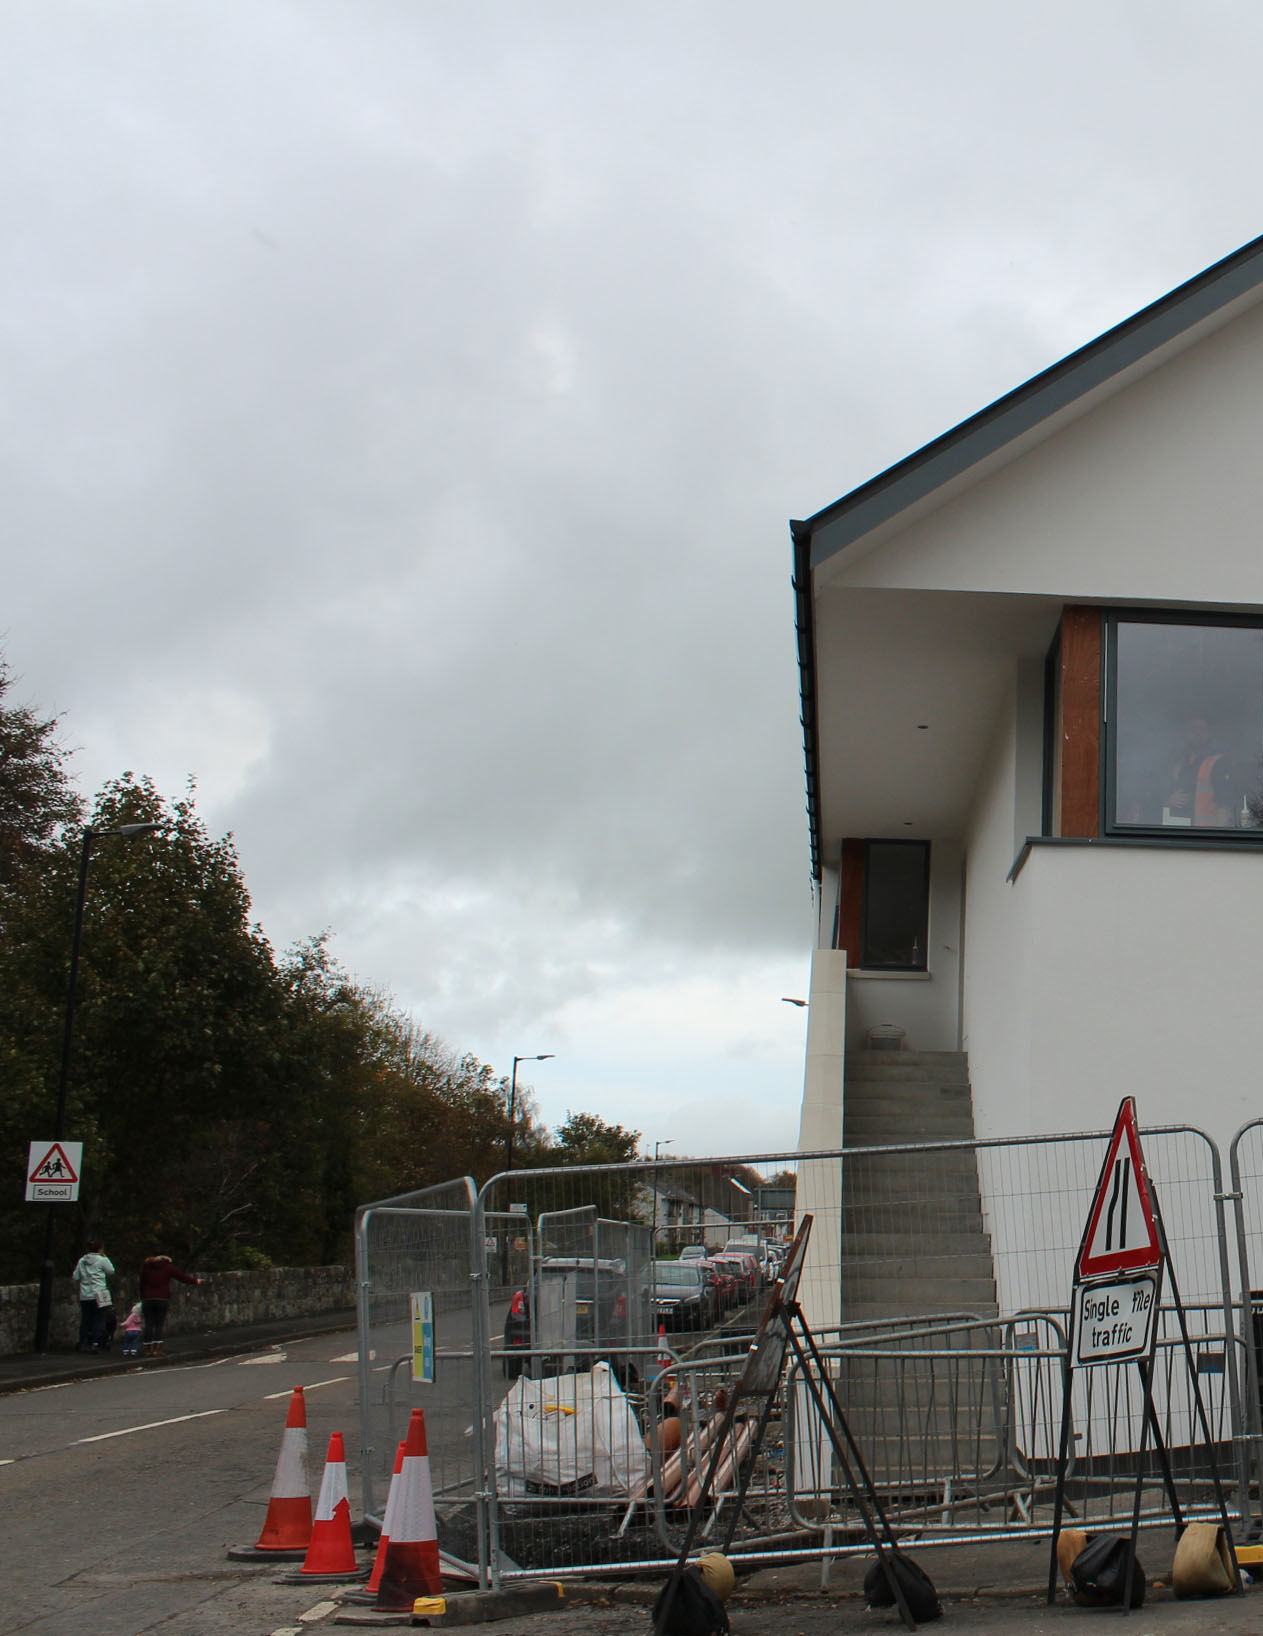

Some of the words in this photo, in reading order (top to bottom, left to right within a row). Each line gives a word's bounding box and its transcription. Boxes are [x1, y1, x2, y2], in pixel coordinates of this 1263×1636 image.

[37, 1188, 67, 1196] School
[1083, 1295, 1120, 1321] Single
[1091, 1322, 1133, 1348] traffic
